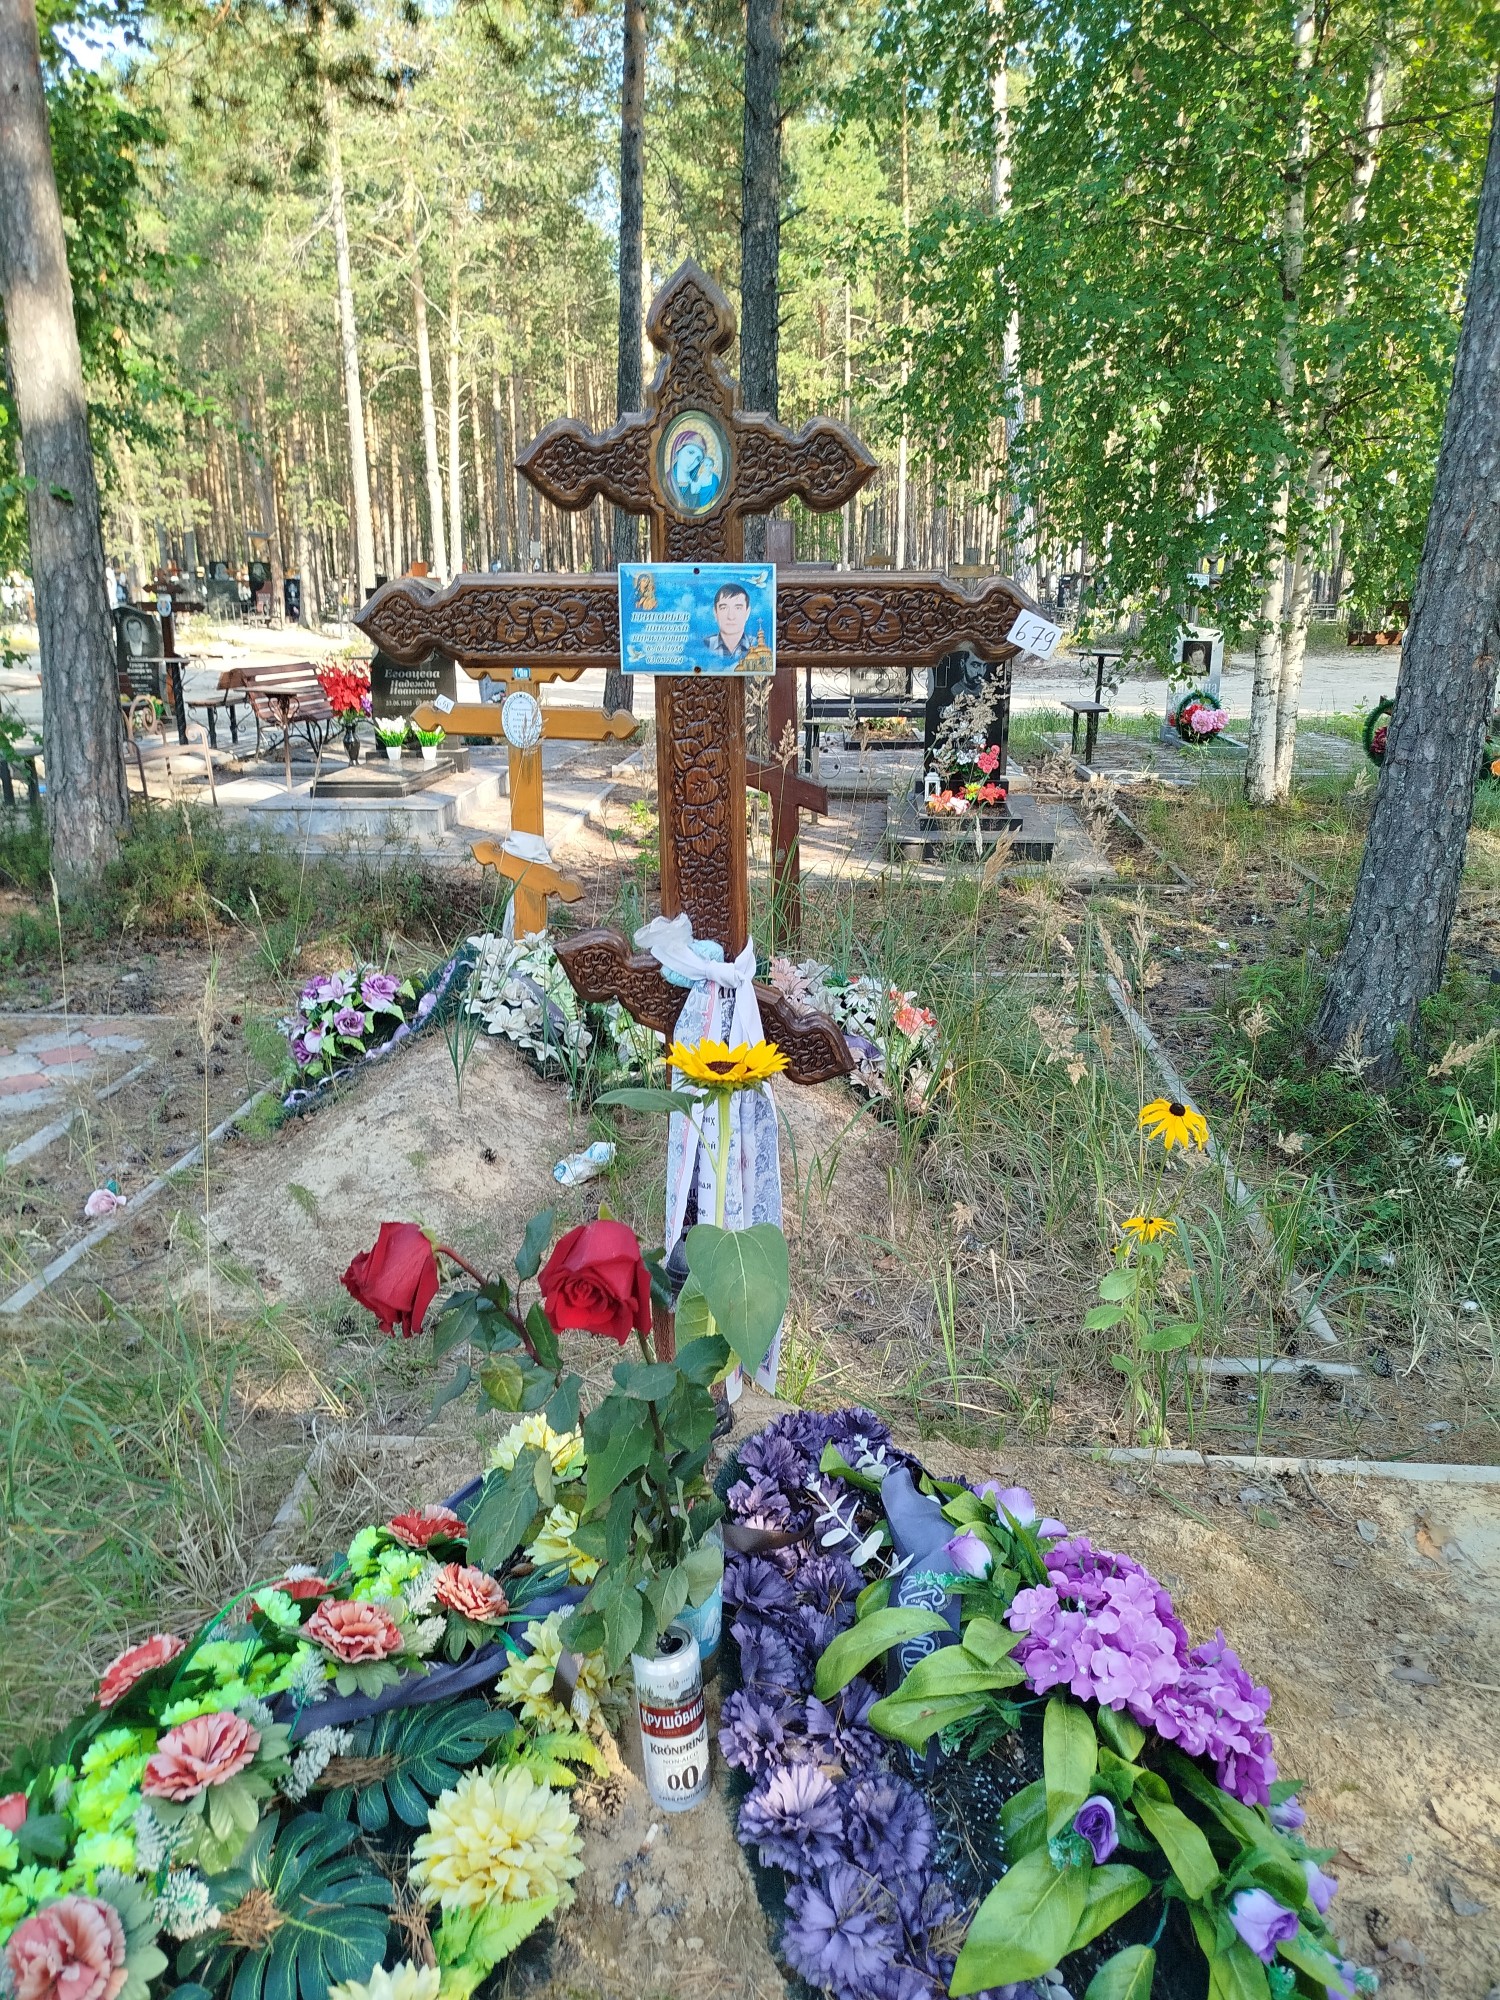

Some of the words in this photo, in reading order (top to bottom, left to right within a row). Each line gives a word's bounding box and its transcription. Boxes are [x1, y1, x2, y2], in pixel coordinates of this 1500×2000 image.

[1014, 619, 1056, 652] 679
[391, 680, 435, 688] Надежда
[390, 687, 437, 695] Ивановна
